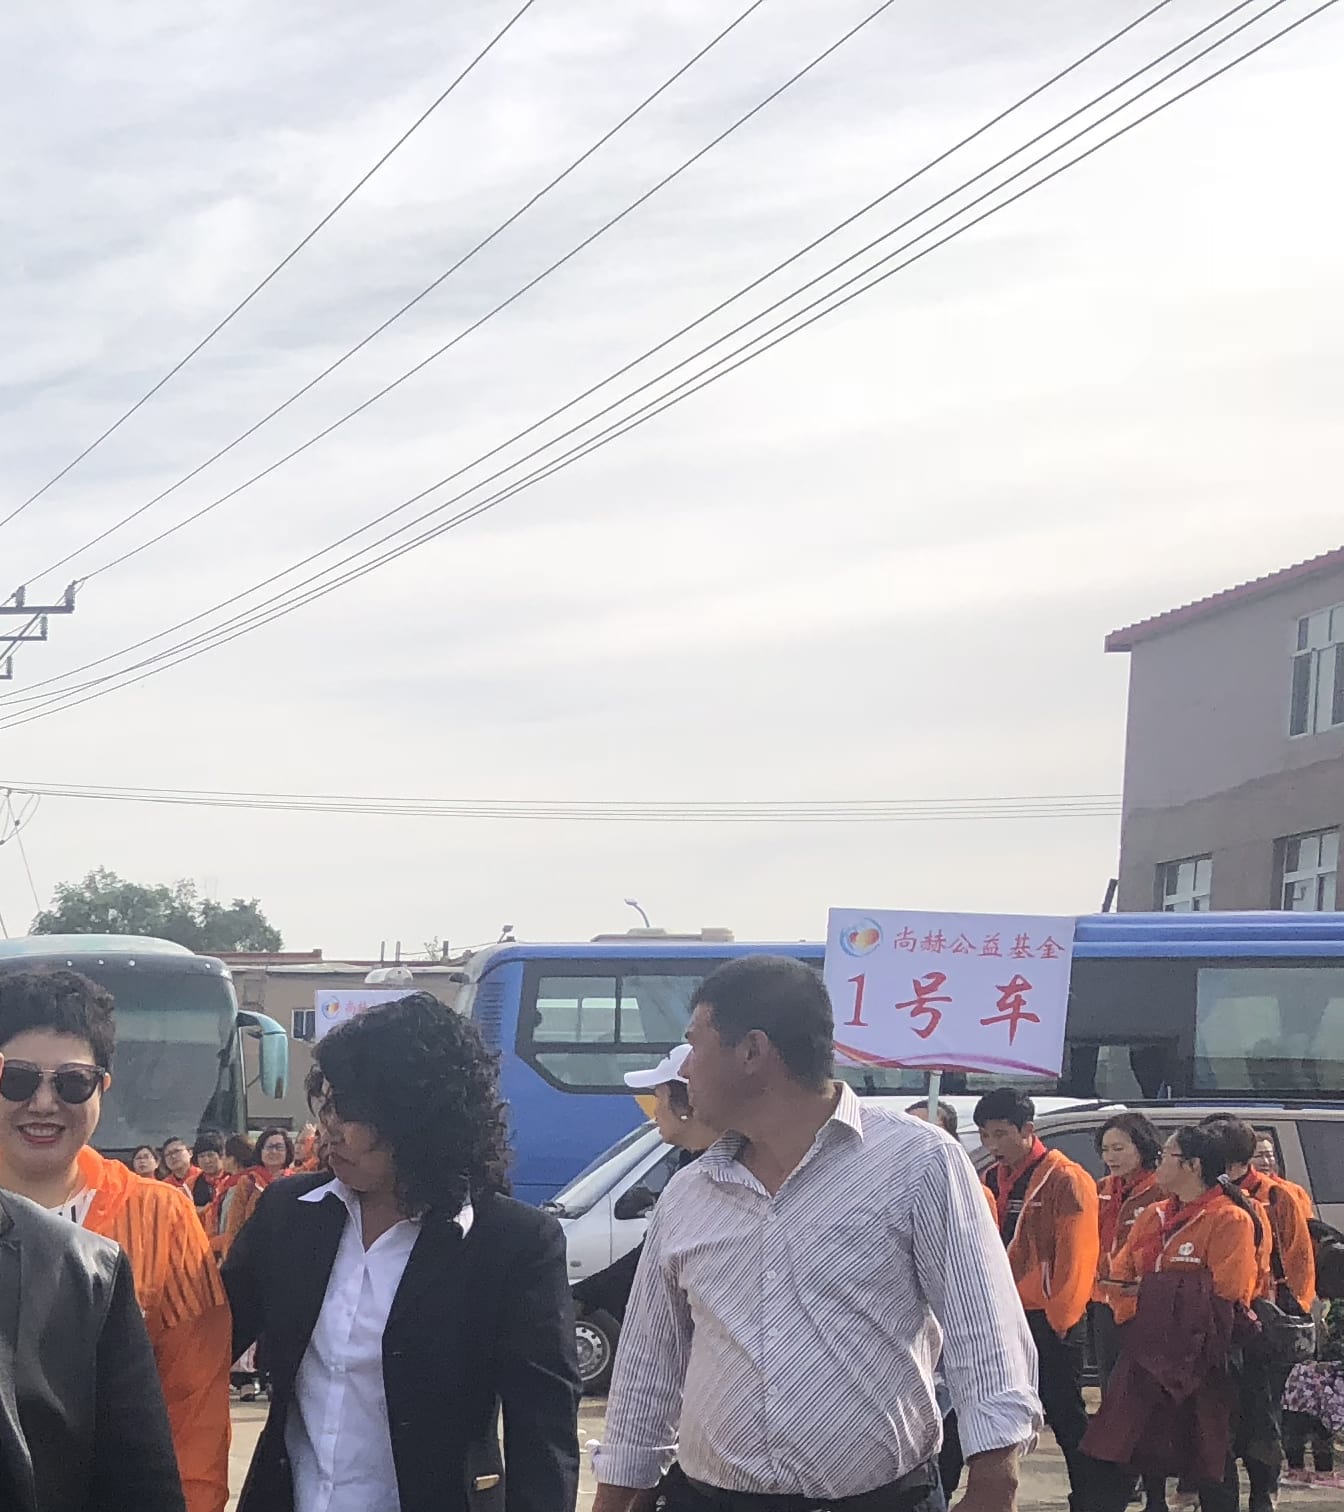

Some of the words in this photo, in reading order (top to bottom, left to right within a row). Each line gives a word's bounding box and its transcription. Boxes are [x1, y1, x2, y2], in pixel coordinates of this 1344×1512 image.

[893, 926, 1065, 960] 尚赫公益基金
[843, 971, 1041, 1046] 1号车
